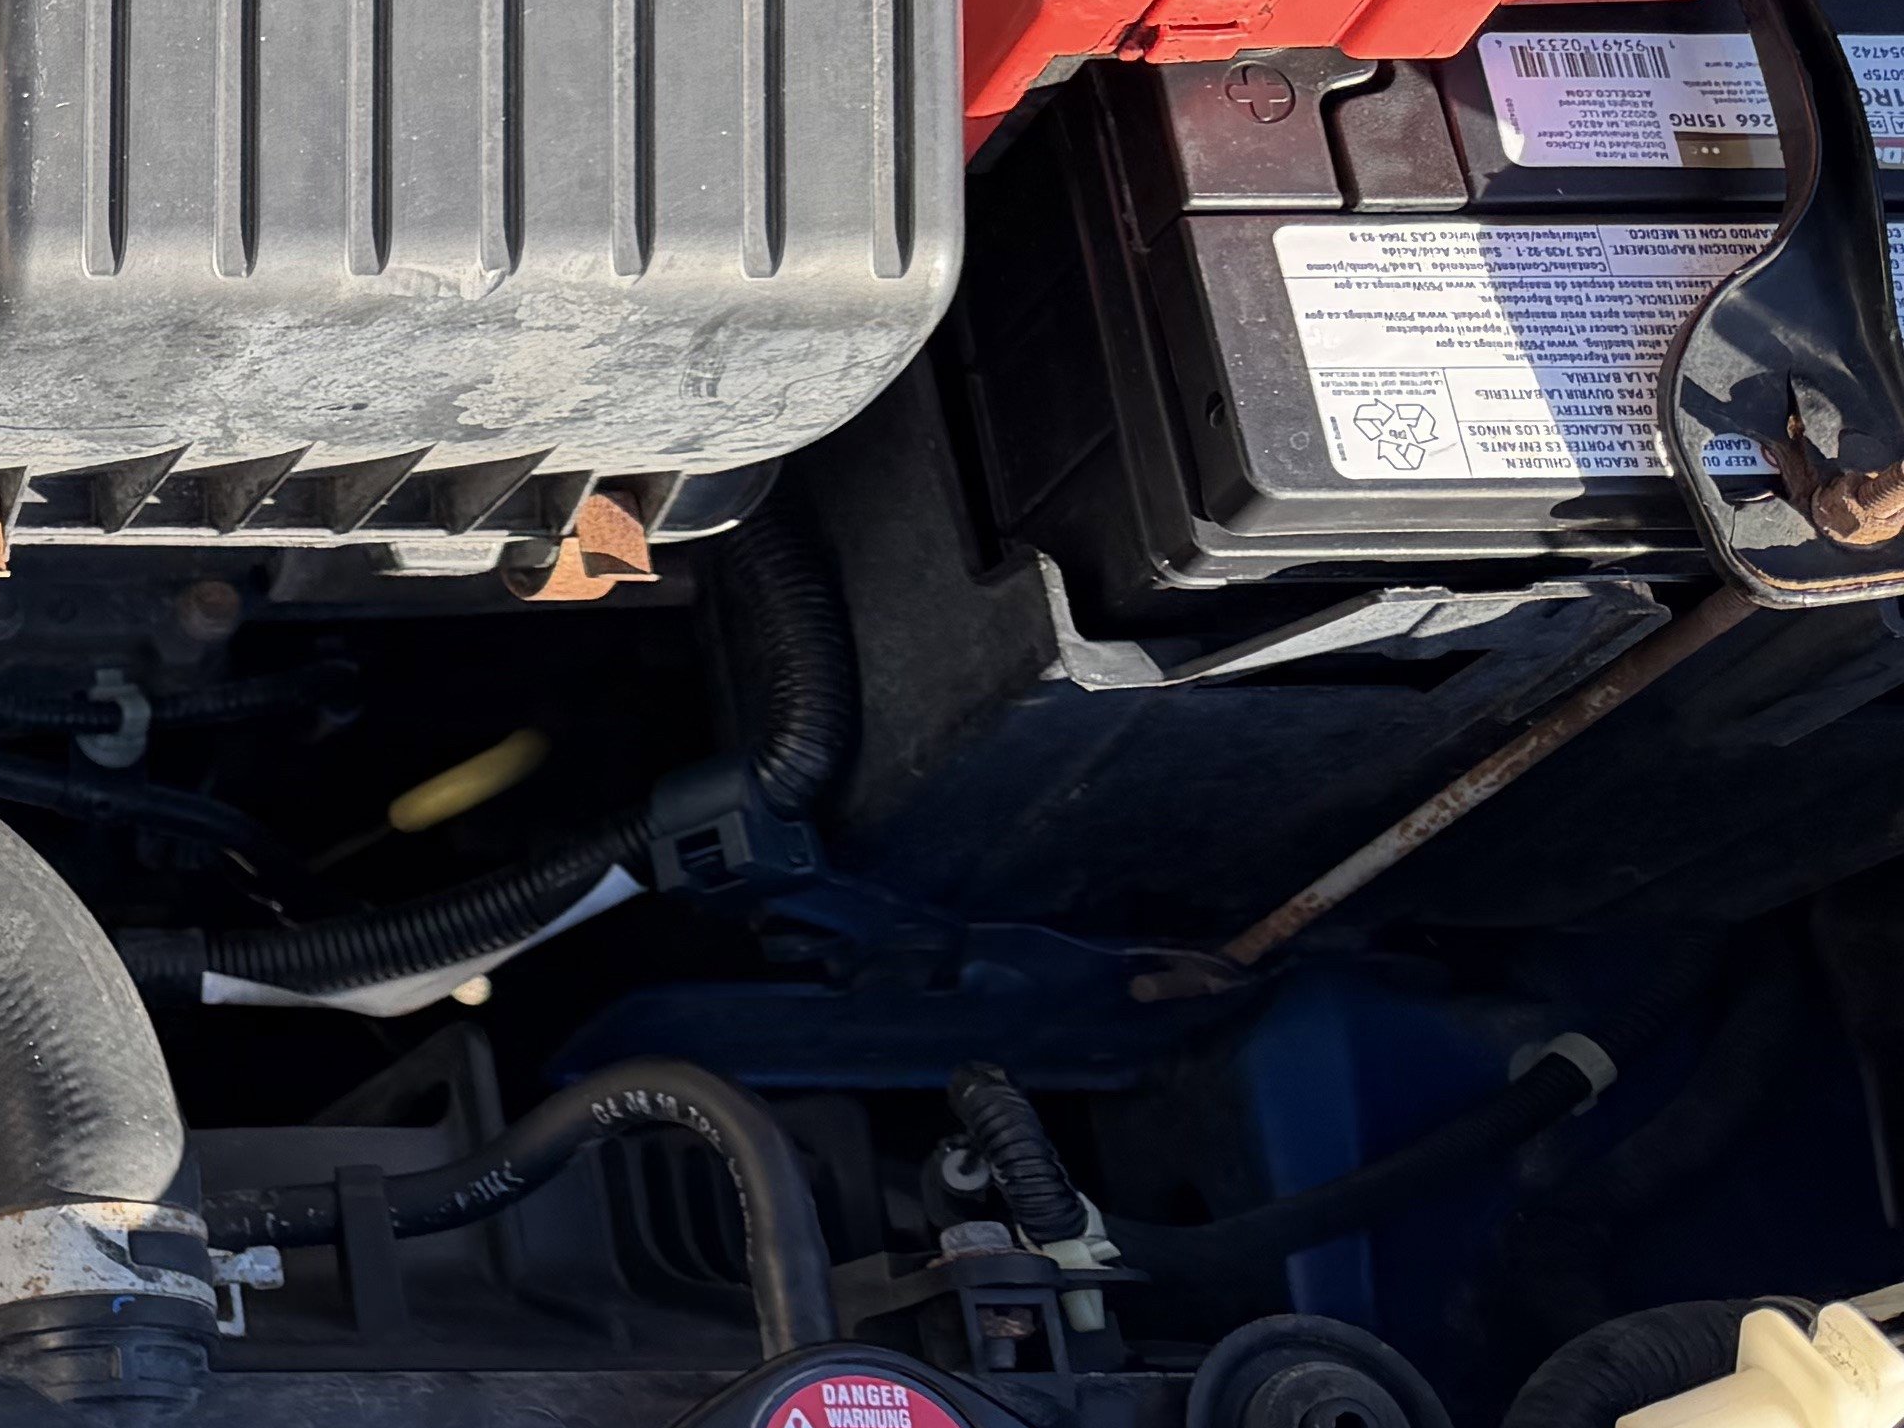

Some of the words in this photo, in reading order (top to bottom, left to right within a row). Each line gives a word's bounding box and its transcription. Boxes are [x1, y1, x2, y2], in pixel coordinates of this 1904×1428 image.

[1526, 39, 1582, 51] 02331
[1589, 39, 1645, 51] 95491
[1565, 89, 1651, 98] ACDELCO.COM
[1668, 113, 1726, 127] 151RG
[1537, 130, 1572, 139] Center
[1575, 130, 1638, 139] Renaissance
[1546, 141, 1590, 150] ACDelco
[1594, 139, 1605, 150] by
[1608, 141, 1666, 150] Distributed
[1596, 151, 1626, 160] Korea
[1641, 151, 1669, 160] Made
[1410, 231, 1436, 242] CAS
[1682, 229, 1696, 240] EL
[1699, 229, 1726, 240] CON
[1575, 246, 1602, 257] CAS
[1608, 244, 1694, 256] RAPIDEMENT.
[1570, 278, 1615, 291] después
[1656, 280, 1673, 291] las
[1623, 311, 1655, 321] mains
[1526, 324, 1575, 335] Troubles
[1588, 324, 1628, 335] Cancer
[1537, 350, 1609, 363] Reproductive
[1612, 353, 1631, 363] and
[1625, 372, 1642, 384] LA
[1545, 388, 1562, 400] LA
[1565, 388, 1614, 400] OUVRIR
[1618, 388, 1643, 400] PAS
[1552, 405, 1613, 416] BATTERY.
[1617, 405, 1652, 416] OPEN
[1515, 424, 1539, 435] LOS
[1563, 424, 1623, 435] ALCANCE
[1627, 424, 1651, 435] DEL
[1476, 442, 1541, 453] ENFANTS.
[1619, 440, 1635, 451] LA
[1639, 440, 1654, 451] DE
[1704, 439, 1751, 451] GARDE
[1502, 456, 1571, 468] CHILDREN.
[1574, 456, 1591, 468] OF
[1595, 456, 1638, 468] REACH
[1702, 456, 1720, 468] OU
[1725, 456, 1757, 468] KEEP
[822, 1384, 909, 1407] DANGER
